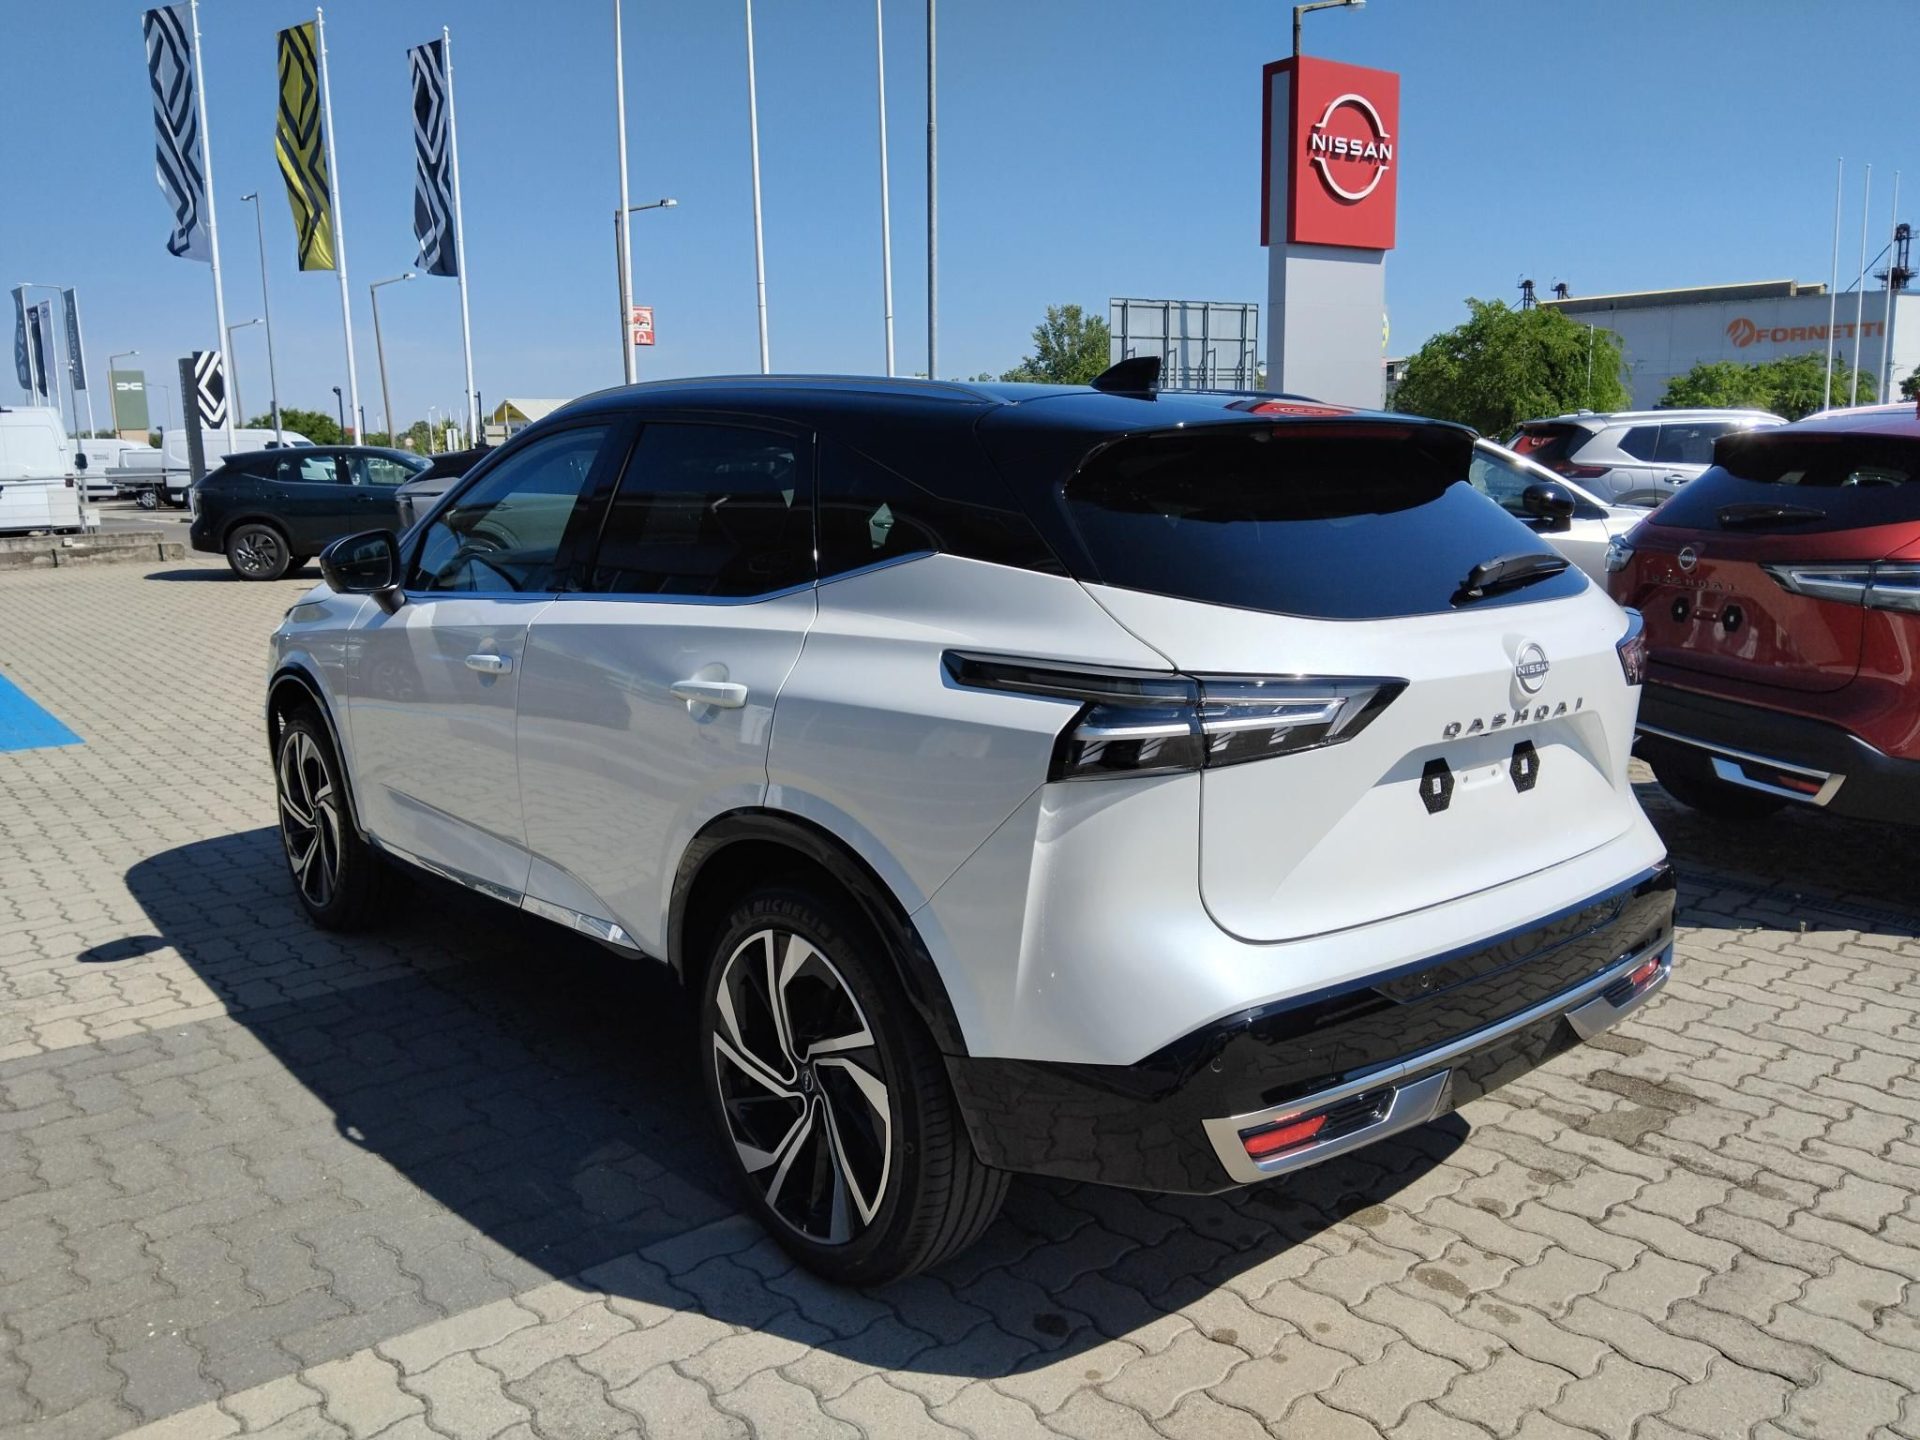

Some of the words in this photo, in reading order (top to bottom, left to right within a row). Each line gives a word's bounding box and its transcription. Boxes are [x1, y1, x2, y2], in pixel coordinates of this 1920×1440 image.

[1310, 133, 1392, 160] NISSAN
[1756, 320, 1885, 343] FORNETTI
[1518, 661, 1550, 676] NISSAN
[1443, 697, 1584, 740] QASHQAI
